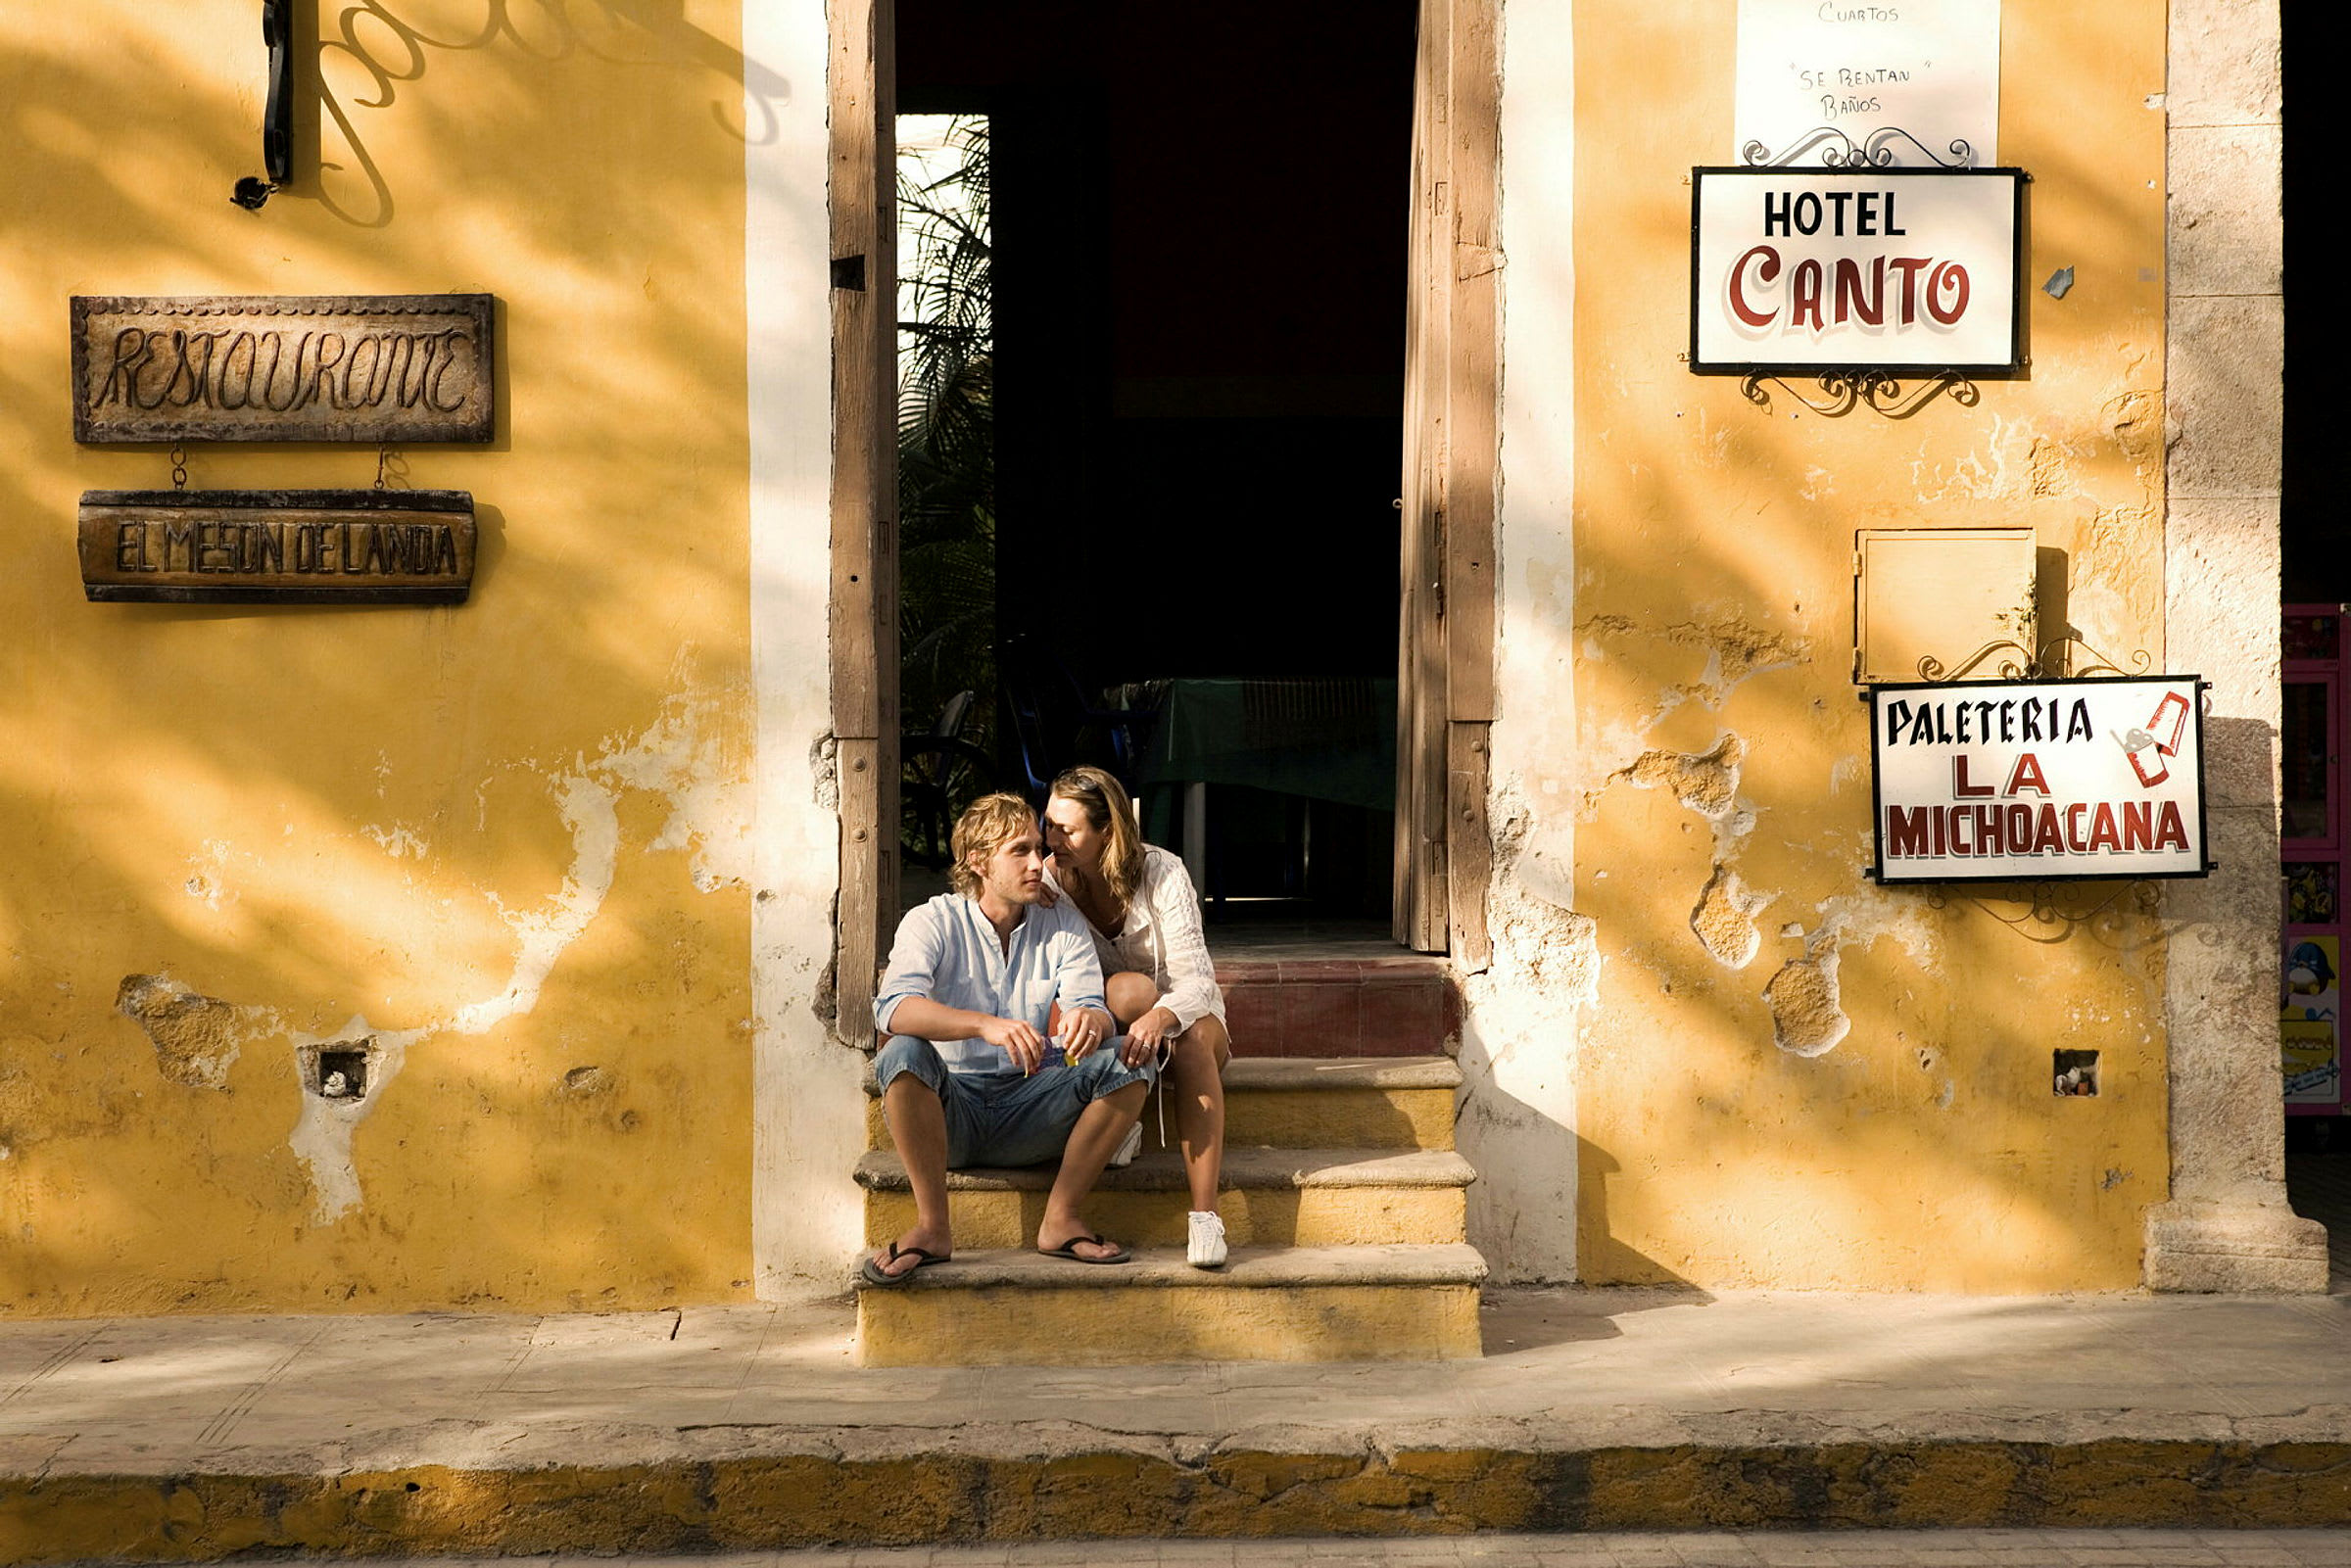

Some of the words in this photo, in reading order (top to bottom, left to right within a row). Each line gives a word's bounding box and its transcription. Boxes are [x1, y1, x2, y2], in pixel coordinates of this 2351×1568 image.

[1818, 1, 1898, 23] CUARTOS
[1820, 94, 1881, 120] BAÑOS
[1764, 191, 1906, 237] HOTEL
[1726, 245, 1970, 336] CANTO
[92, 327, 470, 412] RESTAURANTE
[117, 521, 157, 572] EL
[164, 521, 284, 574] MESON
[296, 523, 335, 573] DE
[1887, 696, 2093, 746] PALETERIA
[1951, 752, 2052, 800] LA
[1885, 800, 2191, 859] MICHOACANA
